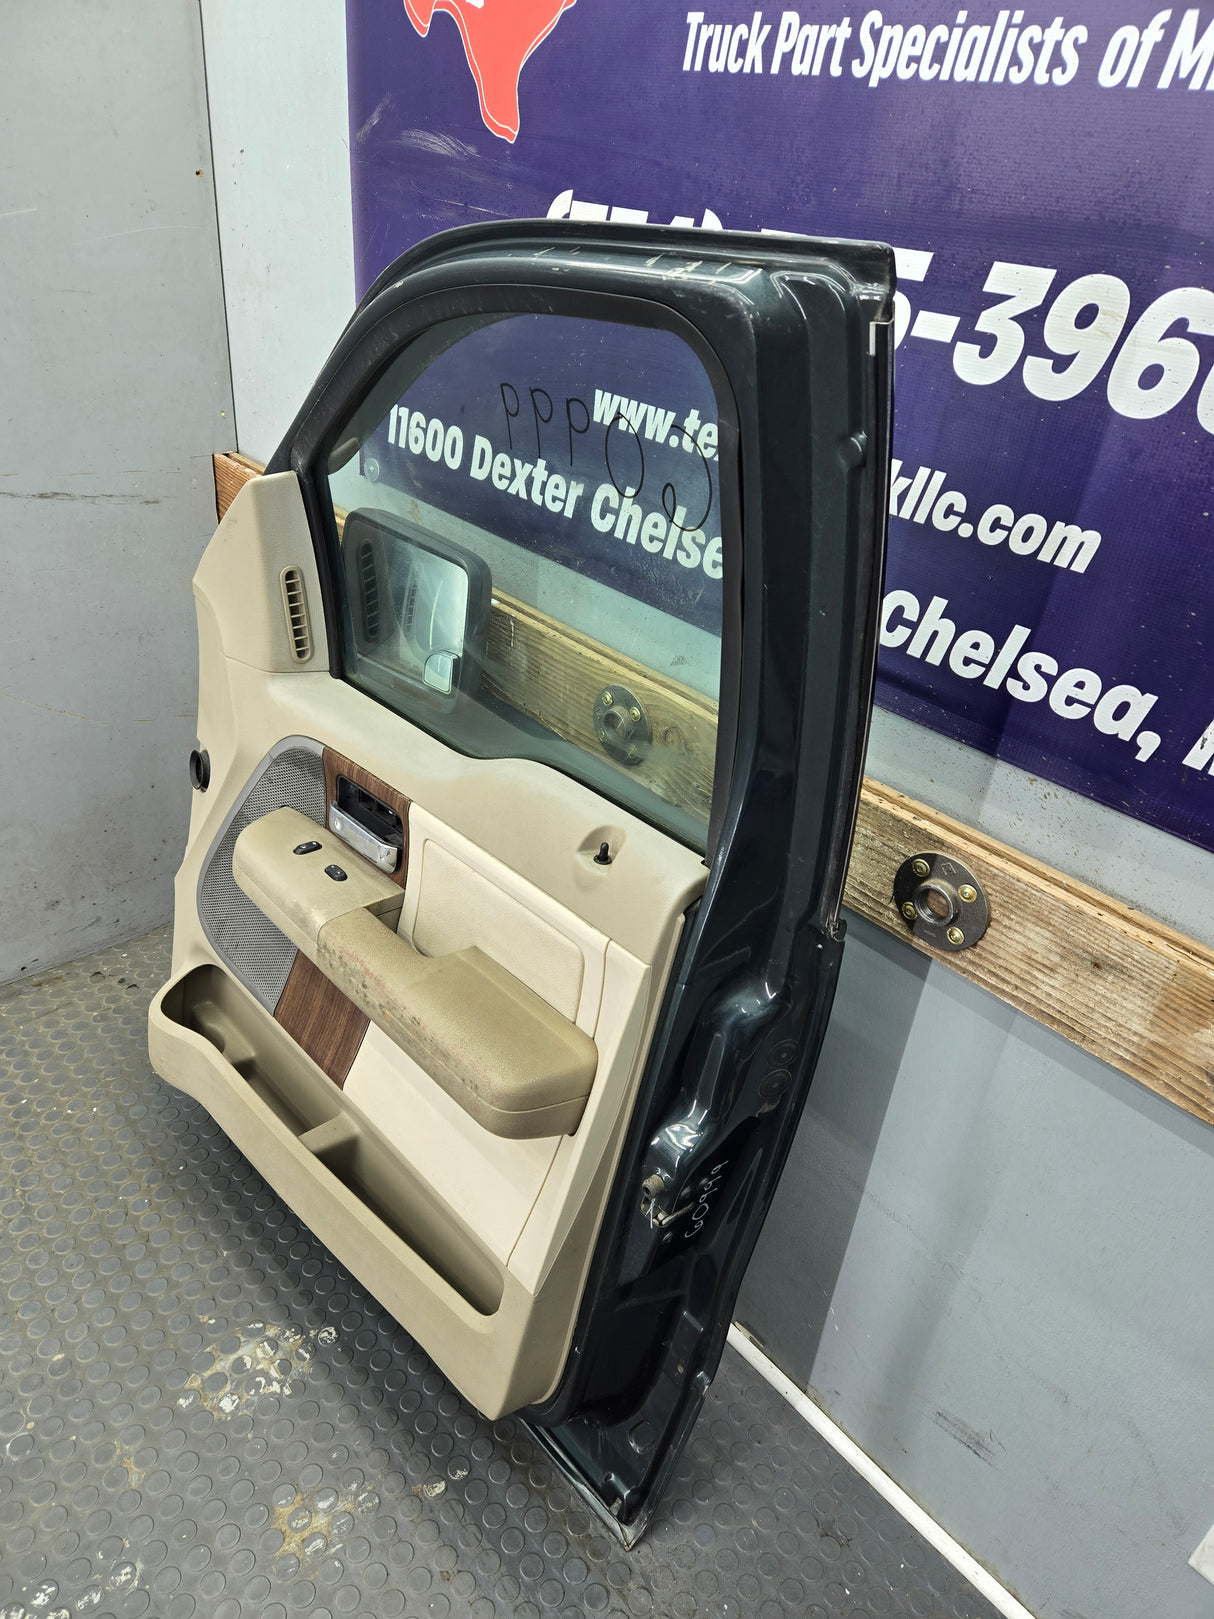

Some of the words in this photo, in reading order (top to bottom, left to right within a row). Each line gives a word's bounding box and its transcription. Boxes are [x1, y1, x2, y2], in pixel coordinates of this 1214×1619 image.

[682, 11, 772, 74] Truck
[770, 11, 852, 77] Part
[851, 9, 1090, 87] Specialists
[1098, 9, 1173, 89] of
[593, 389, 718, 461] www.te
[388, 404, 463, 470] 11600
[470, 434, 584, 518] Dexter
[879, 590, 1161, 762] Chelsea,
